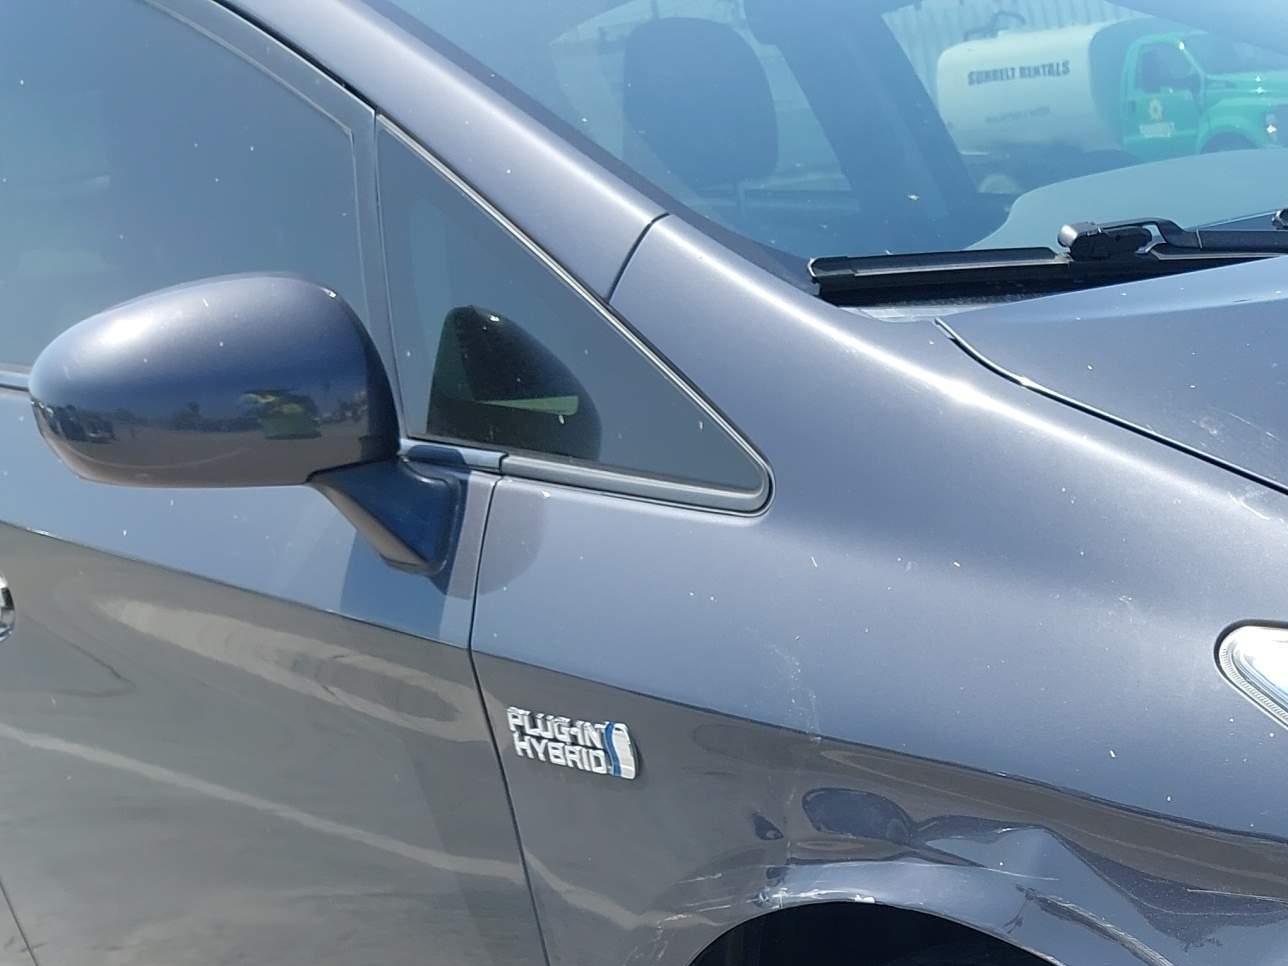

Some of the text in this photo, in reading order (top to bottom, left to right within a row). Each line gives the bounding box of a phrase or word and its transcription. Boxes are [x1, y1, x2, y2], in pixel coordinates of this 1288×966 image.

[1018, 60, 1071, 80] RENTALS
[506, 706, 606, 750] PLUG-IN
[513, 731, 608, 775] HYBRID
